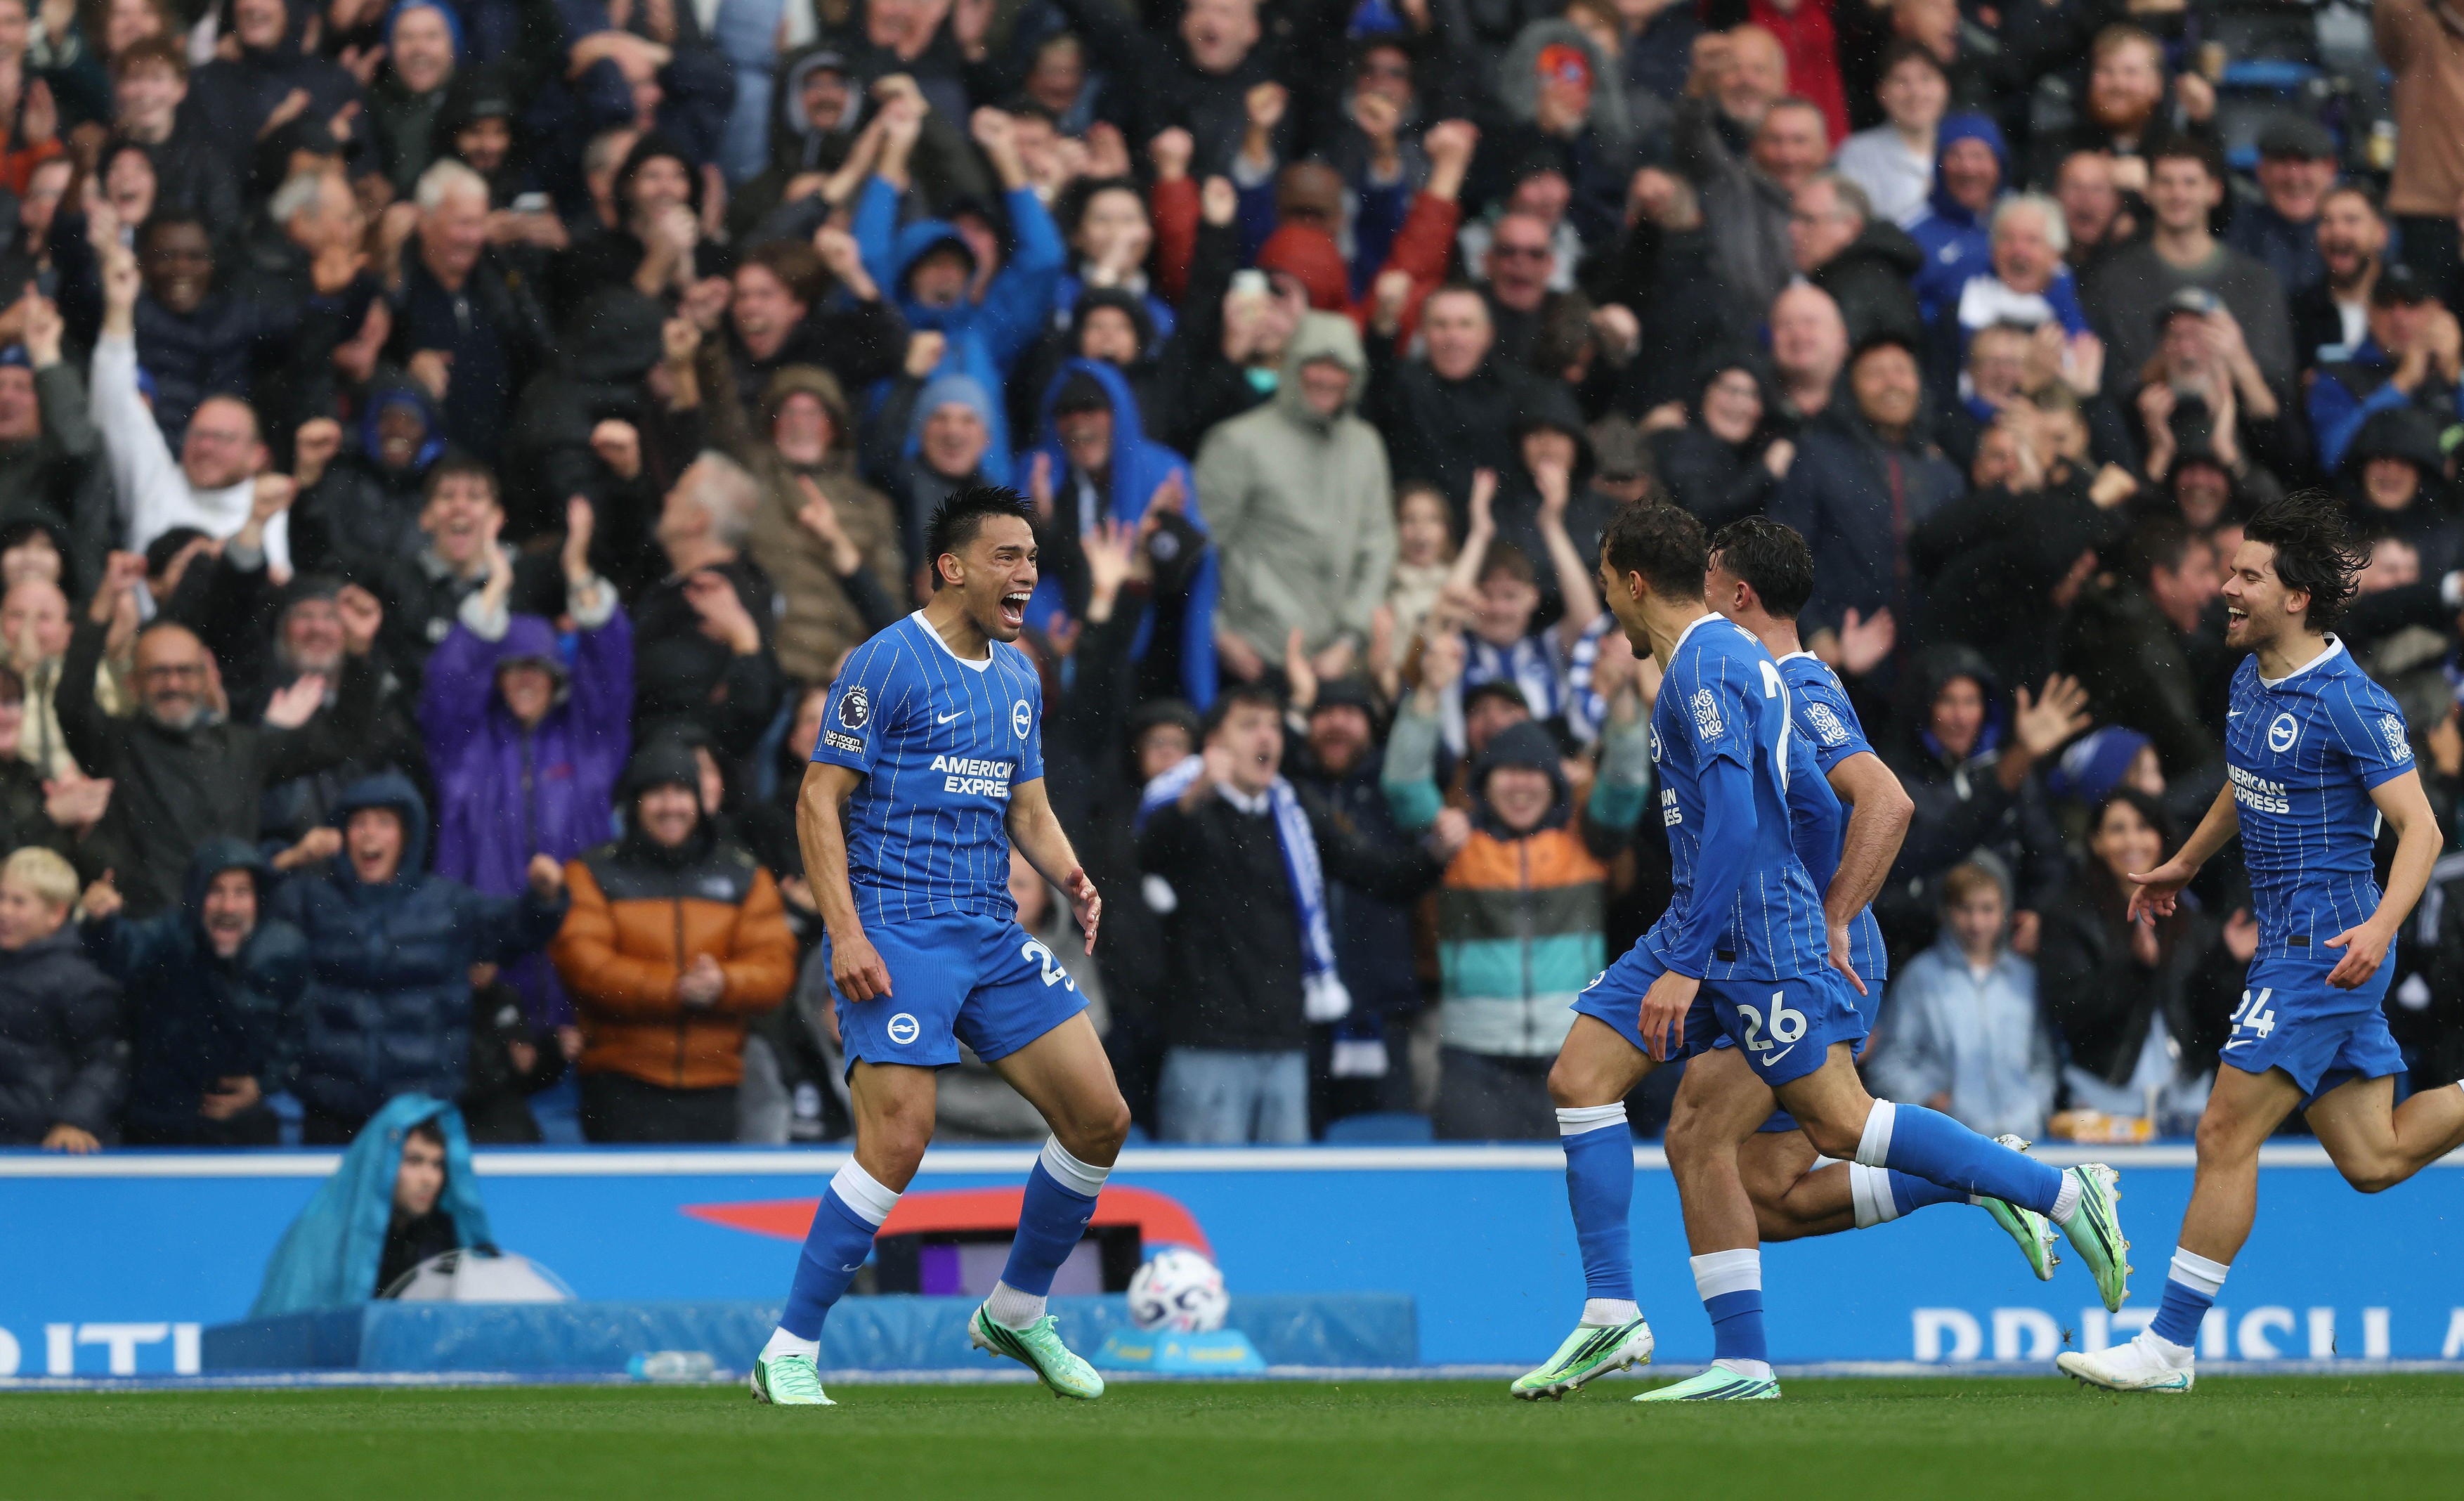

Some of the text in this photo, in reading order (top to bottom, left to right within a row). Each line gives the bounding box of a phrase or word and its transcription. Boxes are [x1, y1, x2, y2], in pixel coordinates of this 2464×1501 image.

[824, 736, 862, 754] for racism
[826, 729, 860, 746] No room
[2227, 762, 2286, 795] MERICAN
[1737, 990, 1807, 1051] 26
